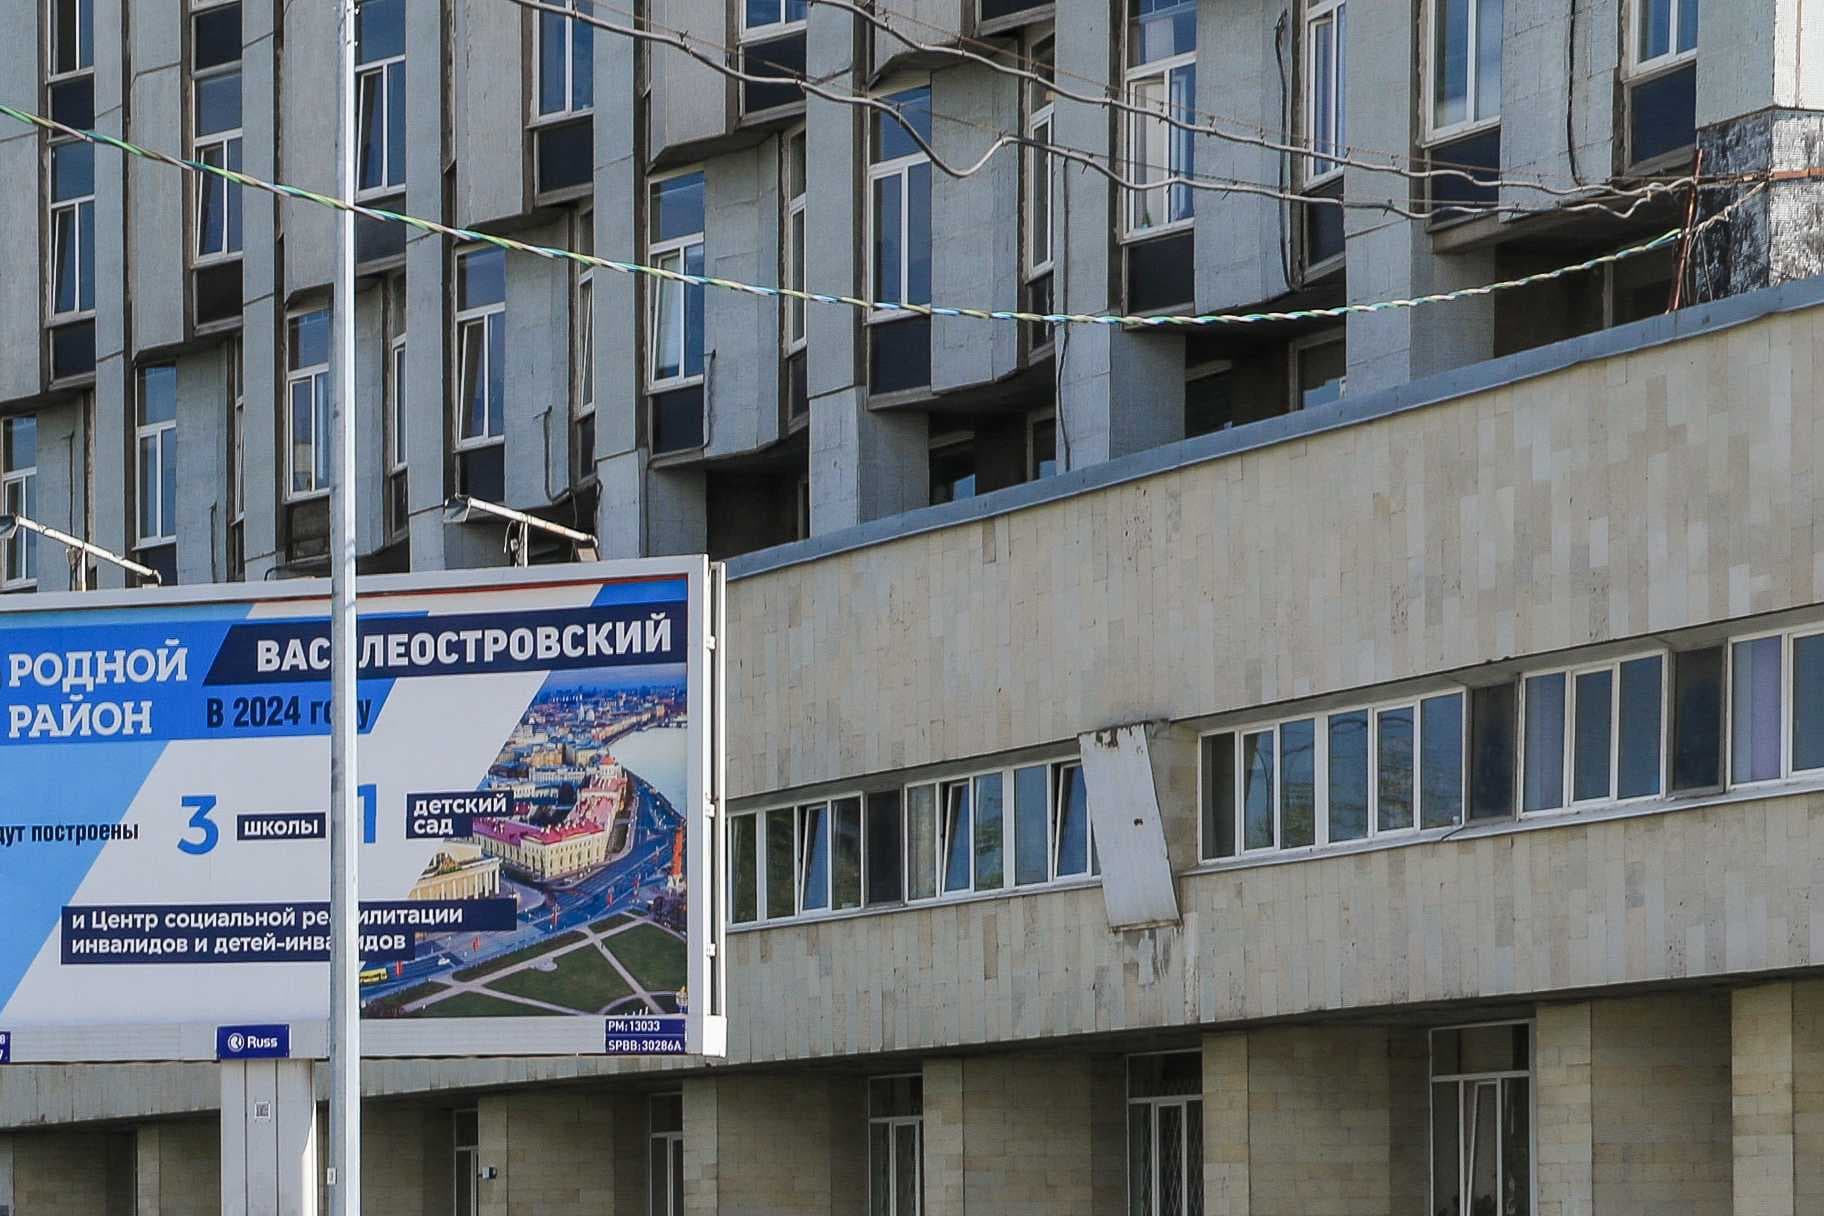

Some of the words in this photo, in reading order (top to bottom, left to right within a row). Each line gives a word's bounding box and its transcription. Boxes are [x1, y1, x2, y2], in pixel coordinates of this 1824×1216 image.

[257, 612, 672, 673] ВАСЛЕОСТРОВСКИЙ
[8, 638, 188, 692] РОДНОЙ
[8, 694, 152, 738] РАЙОН
[207, 697, 224, 729] В
[233, 695, 301, 728] 2024
[311, 698, 372, 730] гу
[177, 794, 220, 855] 3
[244, 819, 318, 836] школы
[358, 783, 377, 844] 1
[413, 793, 507, 816] детский
[413, 817, 454, 835] сад
[32, 823, 139, 846] построены
[72, 914, 85, 929] и
[92, 911, 158, 932] Центр
[165, 907, 296, 930] социальной
[302, 907, 463, 930] реилитации
[72, 937, 188, 955] инвалидов
[194, 937, 208, 953] и
[214, 932, 406, 954] детей-инвдов
[608, 1020, 660, 1032] PM:13033
[247, 1035, 278, 1048] Russ
[608, 1039, 682, 1052] SPBB:30286A
